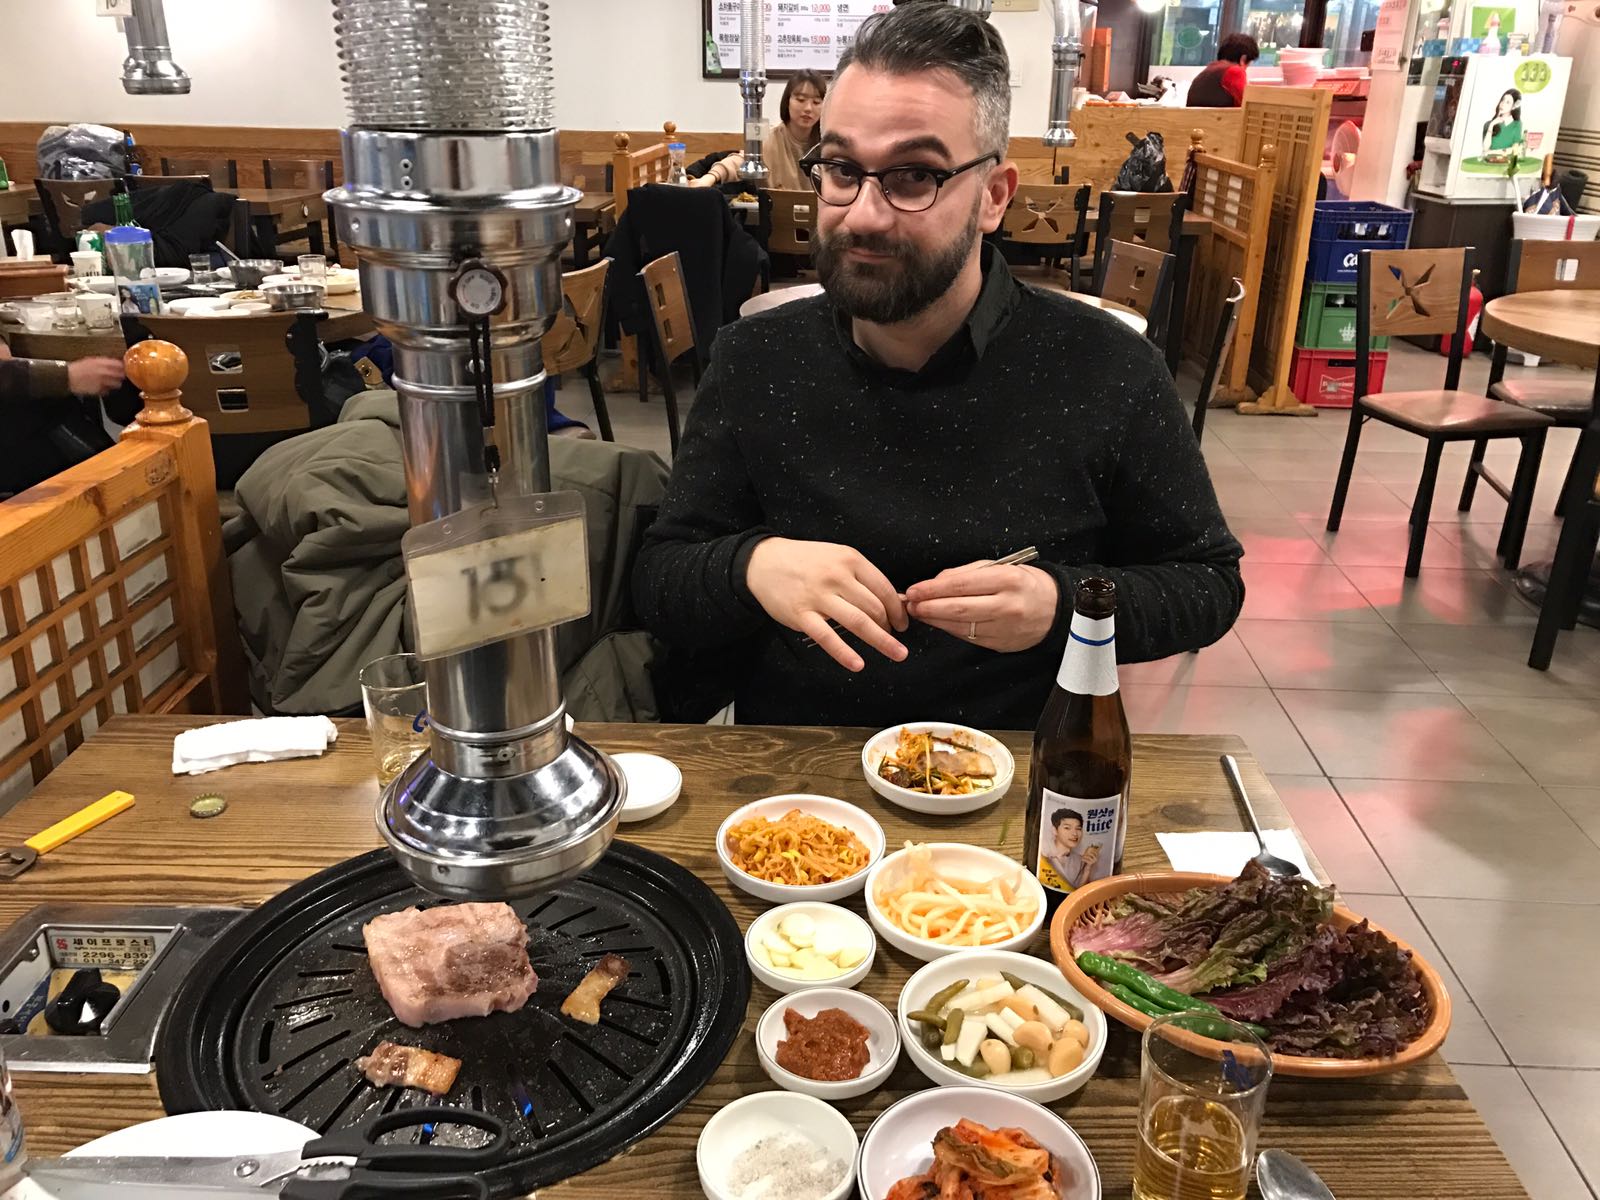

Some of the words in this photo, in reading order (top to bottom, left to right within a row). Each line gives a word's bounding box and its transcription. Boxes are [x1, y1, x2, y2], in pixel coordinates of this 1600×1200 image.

[1343, 252, 1358, 268] Ca
[1086, 819, 1113, 832] hite
[83, 951, 152, 959] 2296-839
